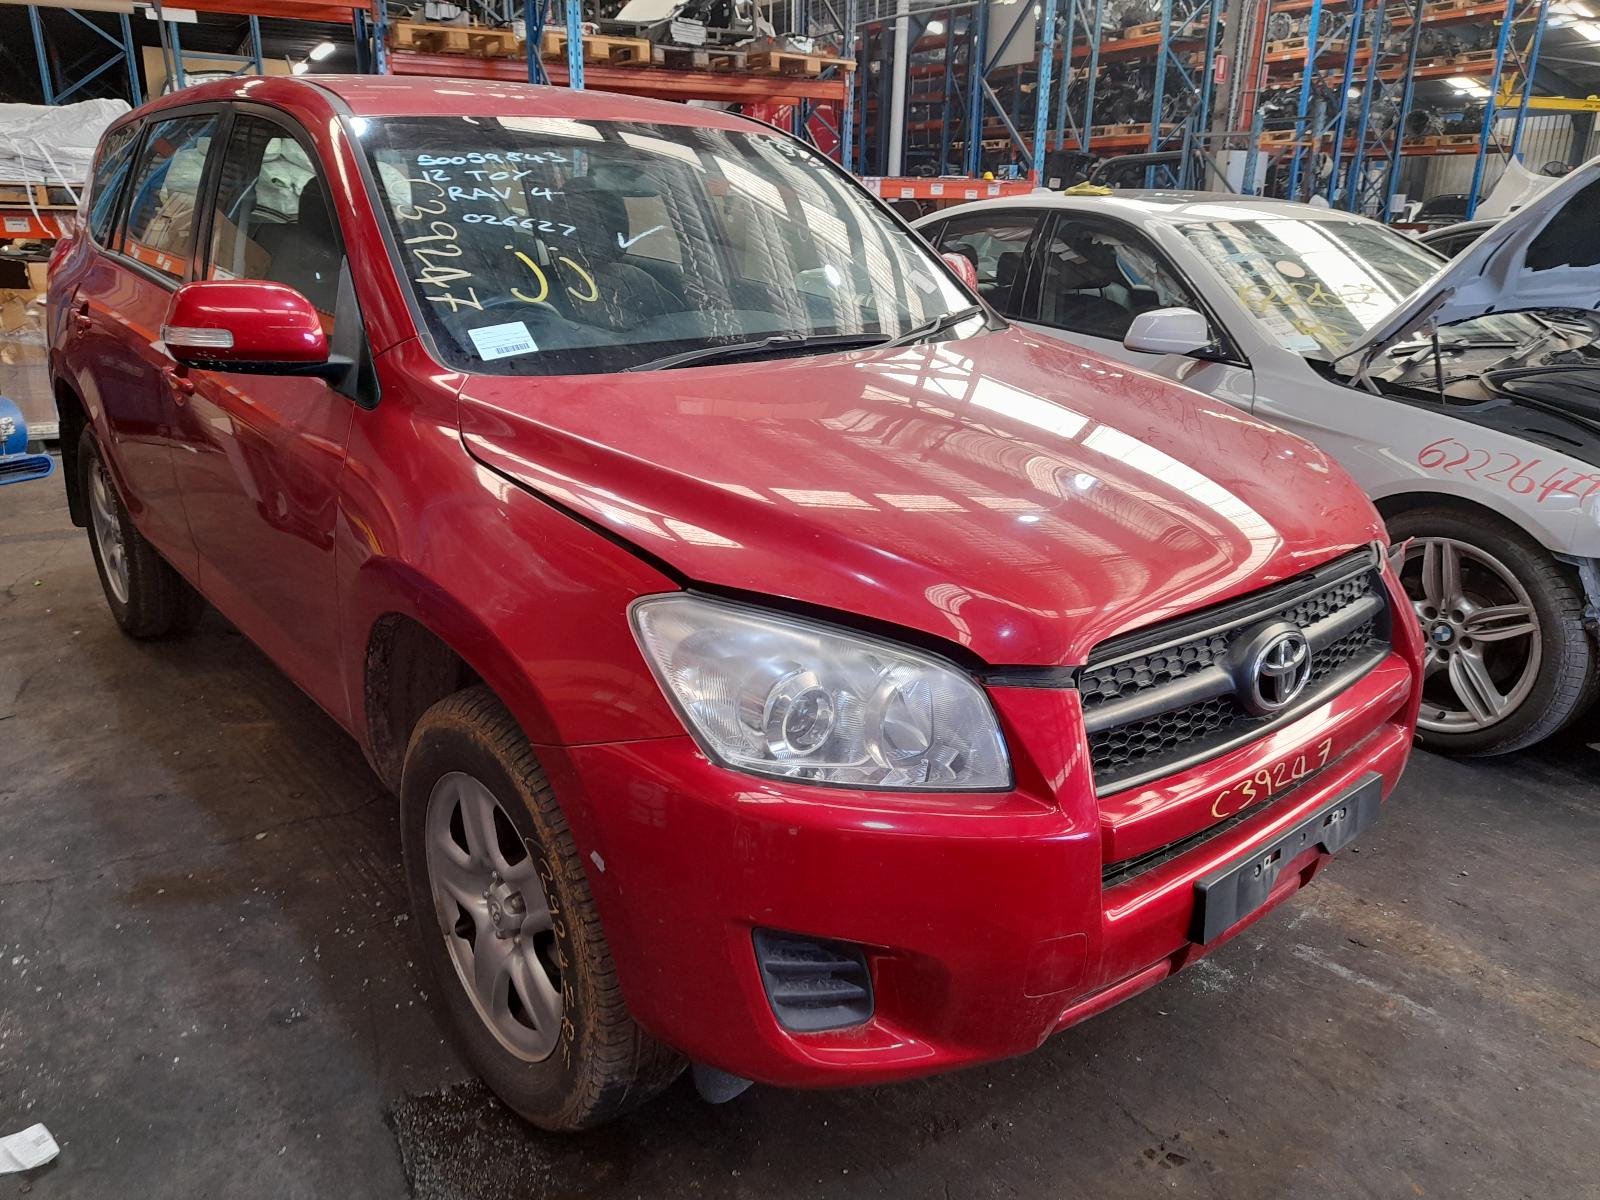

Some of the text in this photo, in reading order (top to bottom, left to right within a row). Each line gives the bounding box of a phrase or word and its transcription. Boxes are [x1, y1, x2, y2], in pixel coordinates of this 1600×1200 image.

[421, 168, 533, 182] 12 TOY
[462, 213, 577, 237] 026627
